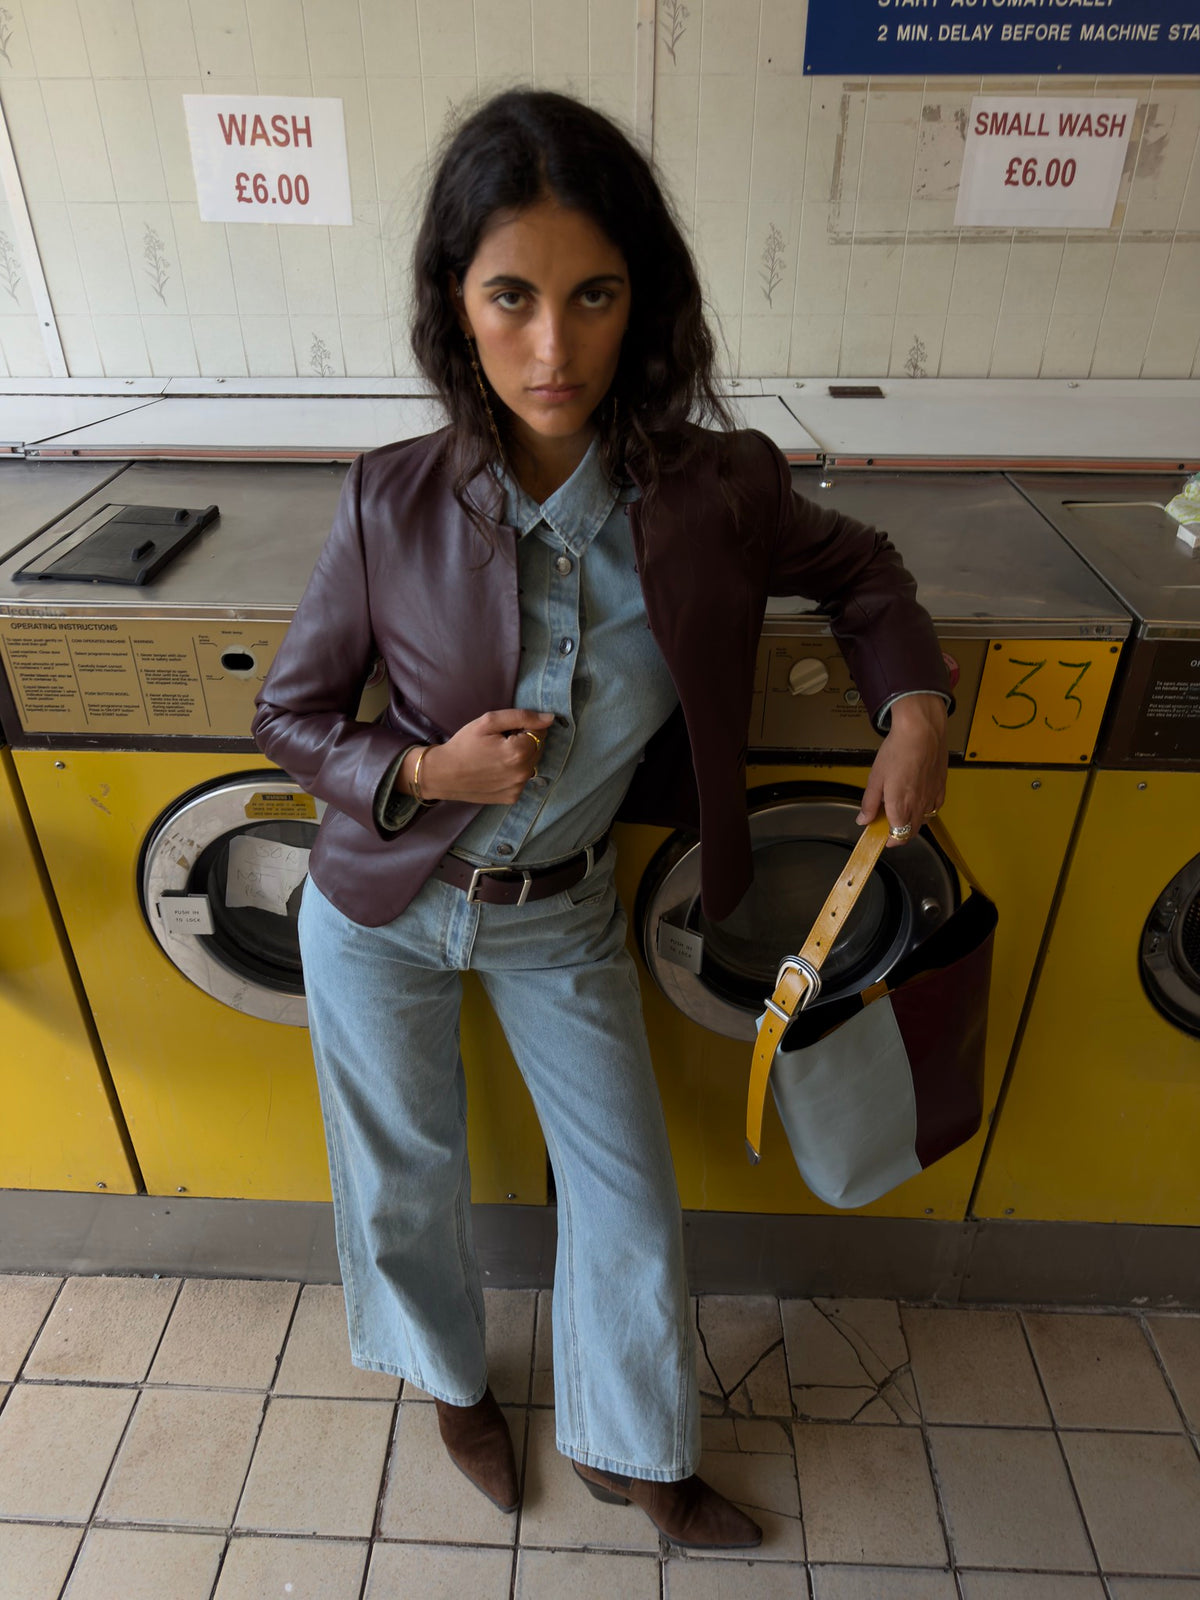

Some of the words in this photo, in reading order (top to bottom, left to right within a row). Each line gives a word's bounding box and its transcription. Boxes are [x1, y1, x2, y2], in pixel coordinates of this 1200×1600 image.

[877, 24, 888, 41] 2
[897, 24, 933, 41] MIN.
[938, 24, 993, 41] DELAY
[1000, 24, 1072, 41] BEFORE
[1079, 24, 1160, 41] MACHINE
[217, 113, 312, 148] WASH
[974, 112, 1050, 136] SMALL
[1058, 113, 1127, 138] WASH
[1004, 157, 1077, 188] £6.00
[235, 172, 310, 205] £6.00
[10, 622, 57, 630] OPERATING
[58, 623, 118, 631] INSTRUCTIONS
[992, 658, 1092, 731] 33
